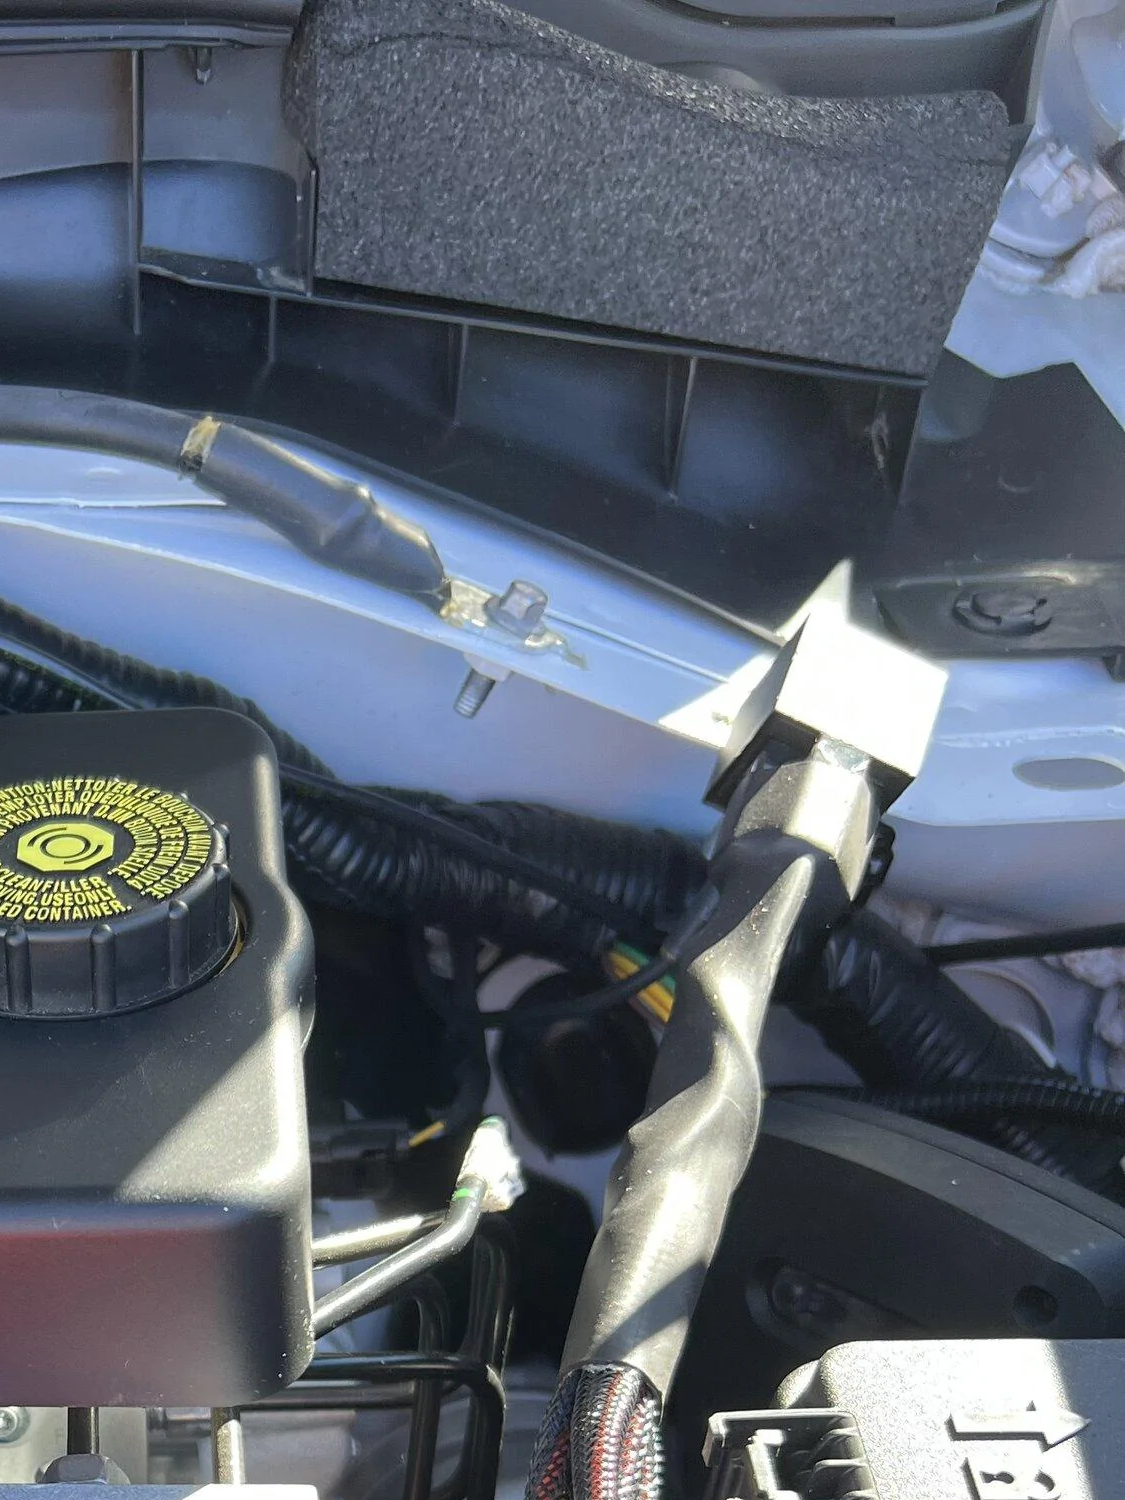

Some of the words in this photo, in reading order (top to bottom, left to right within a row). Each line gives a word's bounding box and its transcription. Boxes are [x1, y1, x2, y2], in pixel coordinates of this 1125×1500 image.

[124, 818, 158, 845] BIDON
[134, 787, 161, 800] LE
[153, 793, 209, 832] BOUCHON
[183, 834, 211, 864] AVANT
[153, 841, 184, 867] FREIN
